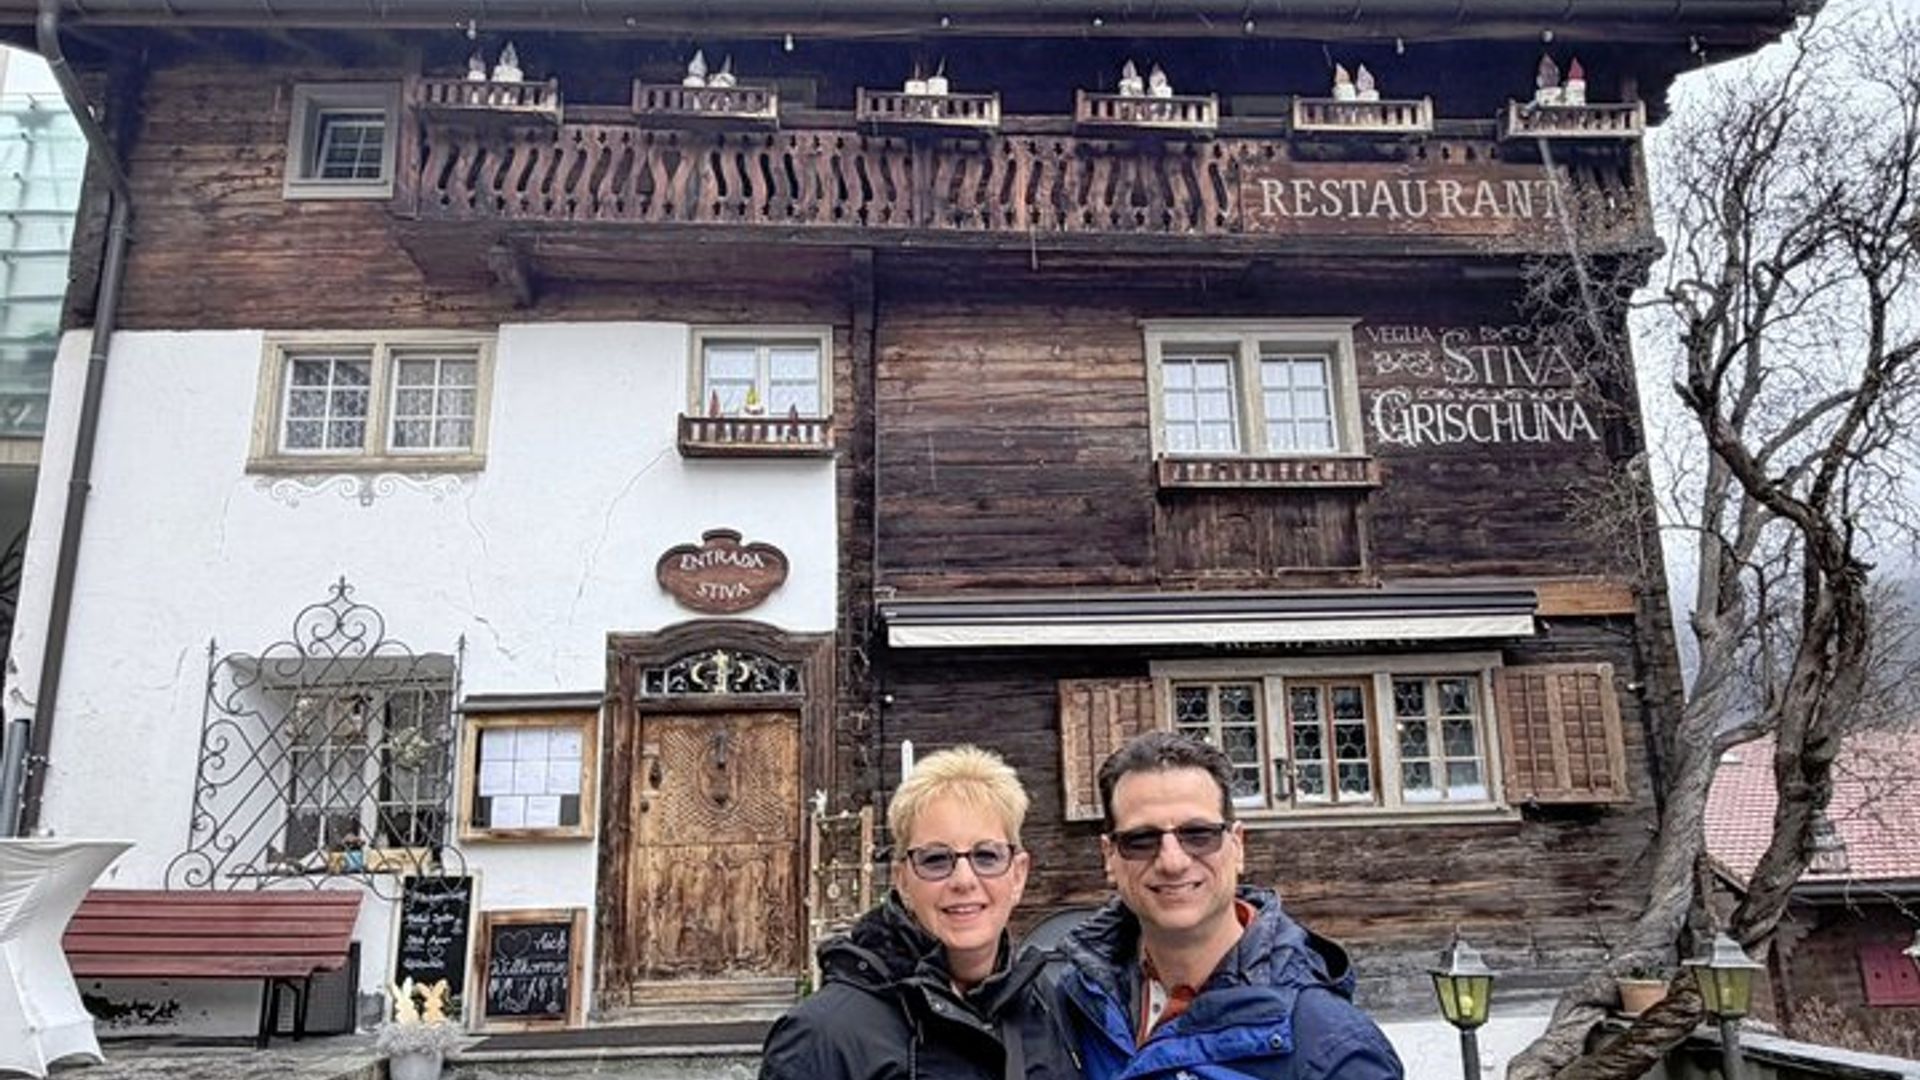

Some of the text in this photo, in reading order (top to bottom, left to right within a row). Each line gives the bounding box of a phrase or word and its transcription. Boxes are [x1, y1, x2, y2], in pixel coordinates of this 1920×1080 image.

[1259, 179, 1560, 219] RESTAURANT
[1365, 325, 1436, 344] VEGLIA
[1441, 329, 1582, 386] STIVA
[1371, 389, 1599, 447] GRISCHUNA
[679, 549, 766, 571] ENTRADA
[696, 581, 751, 599] STIVA
